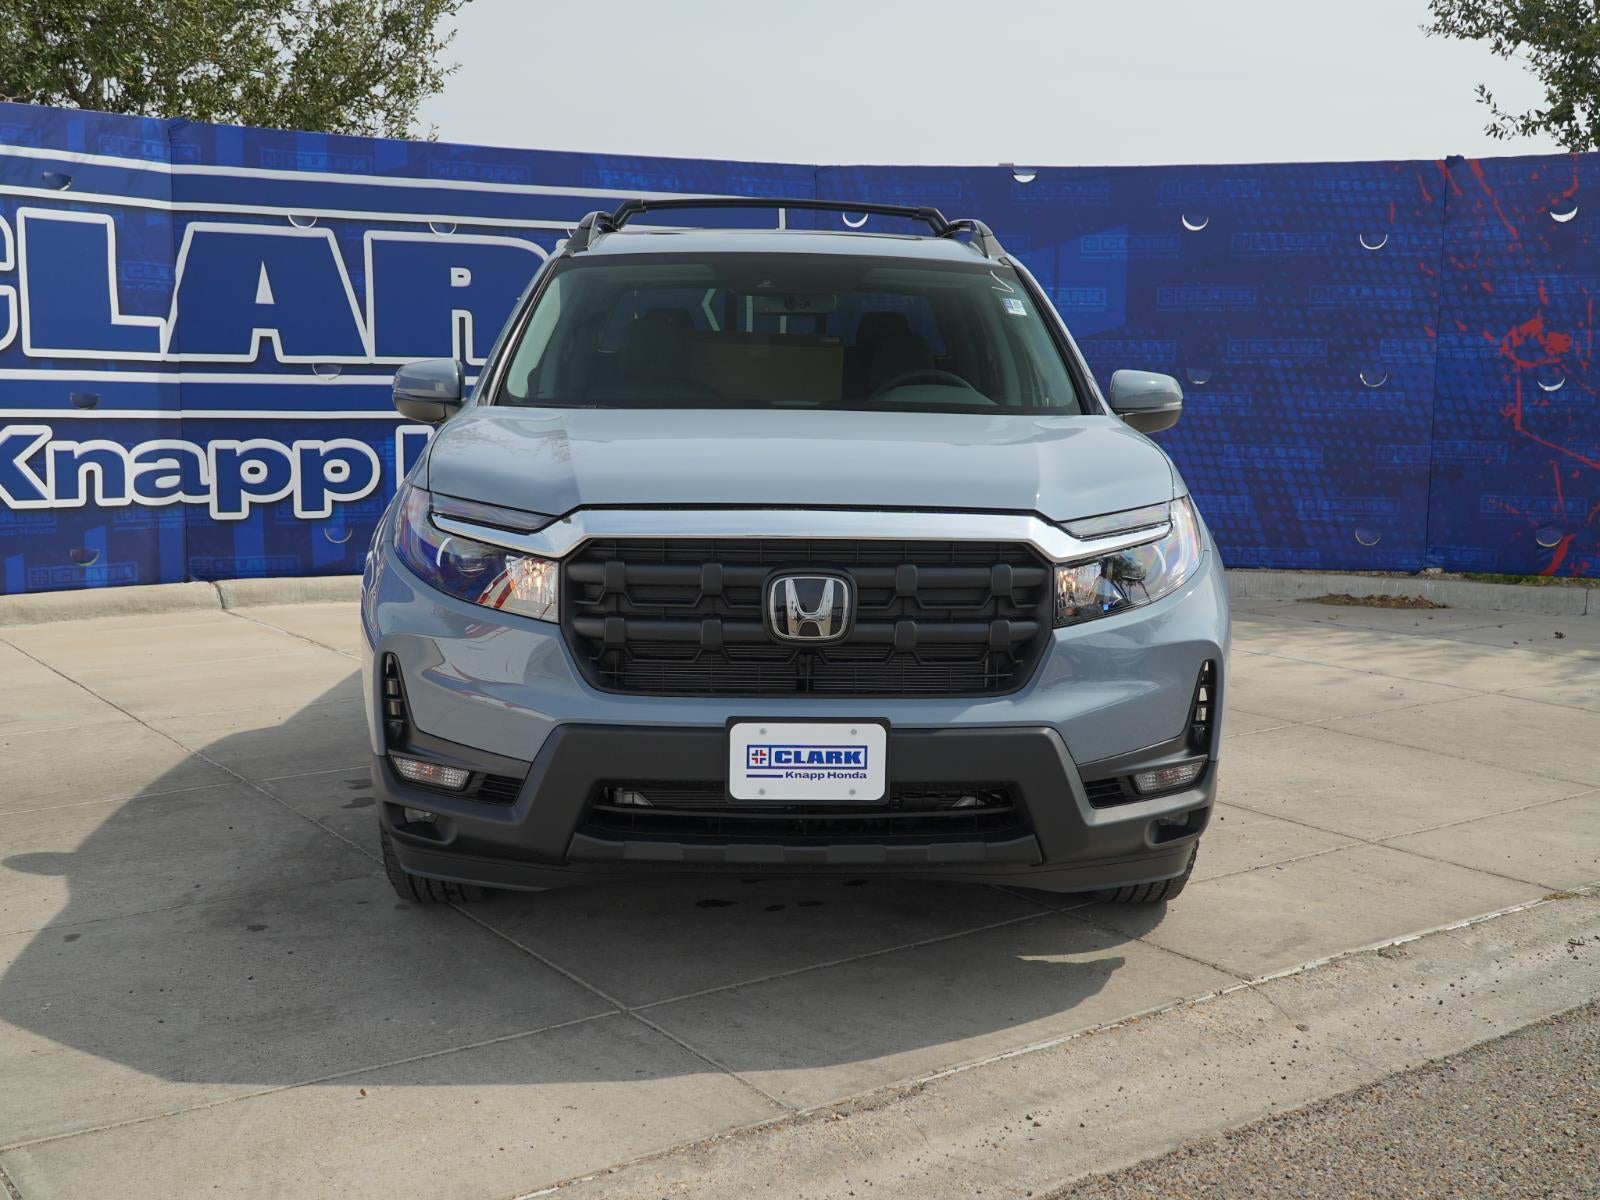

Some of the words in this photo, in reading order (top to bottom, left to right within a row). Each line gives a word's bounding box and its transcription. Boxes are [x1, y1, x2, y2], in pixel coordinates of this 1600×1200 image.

[0, 206, 550, 365] LAR
[0, 424, 381, 520] Knapp
[774, 750, 862, 765] CLARK
[785, 771, 825, 780] Knapp
[827, 771, 867, 779] Honda
